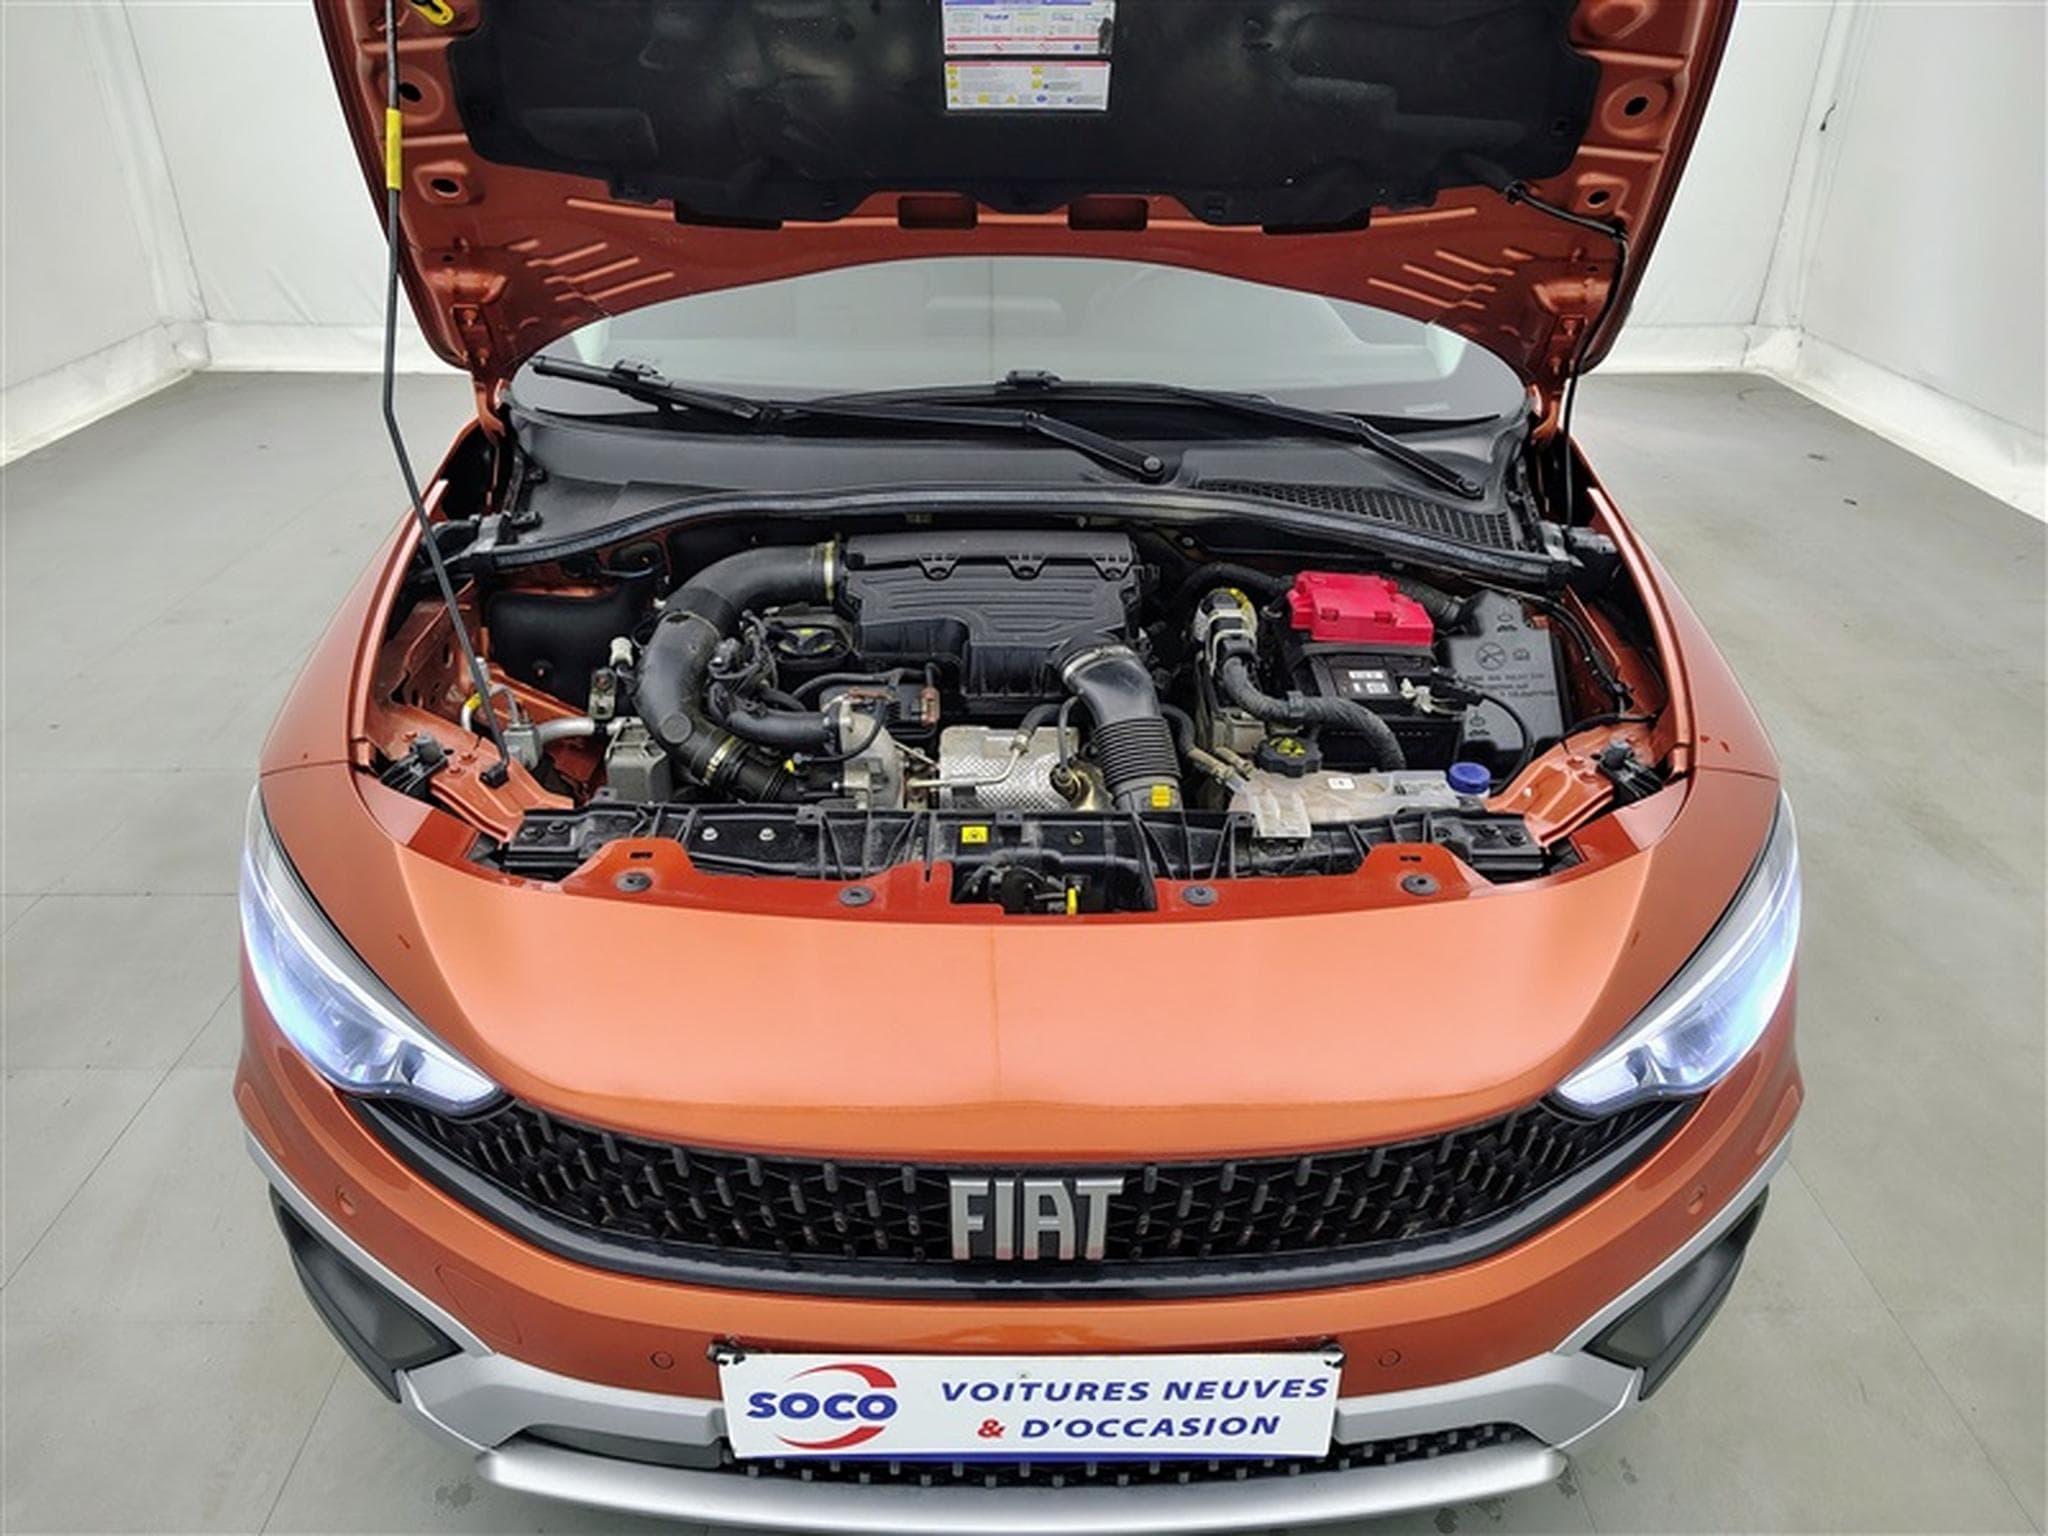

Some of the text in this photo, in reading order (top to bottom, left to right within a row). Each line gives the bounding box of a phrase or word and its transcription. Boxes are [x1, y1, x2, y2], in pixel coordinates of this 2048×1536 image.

[950, 1178, 1124, 1261] FIAT
[941, 1378, 1329, 1403] VOITURES NEUVES
[747, 1390, 899, 1421] SOCO
[977, 1416, 1280, 1440] & D'OCCASION
